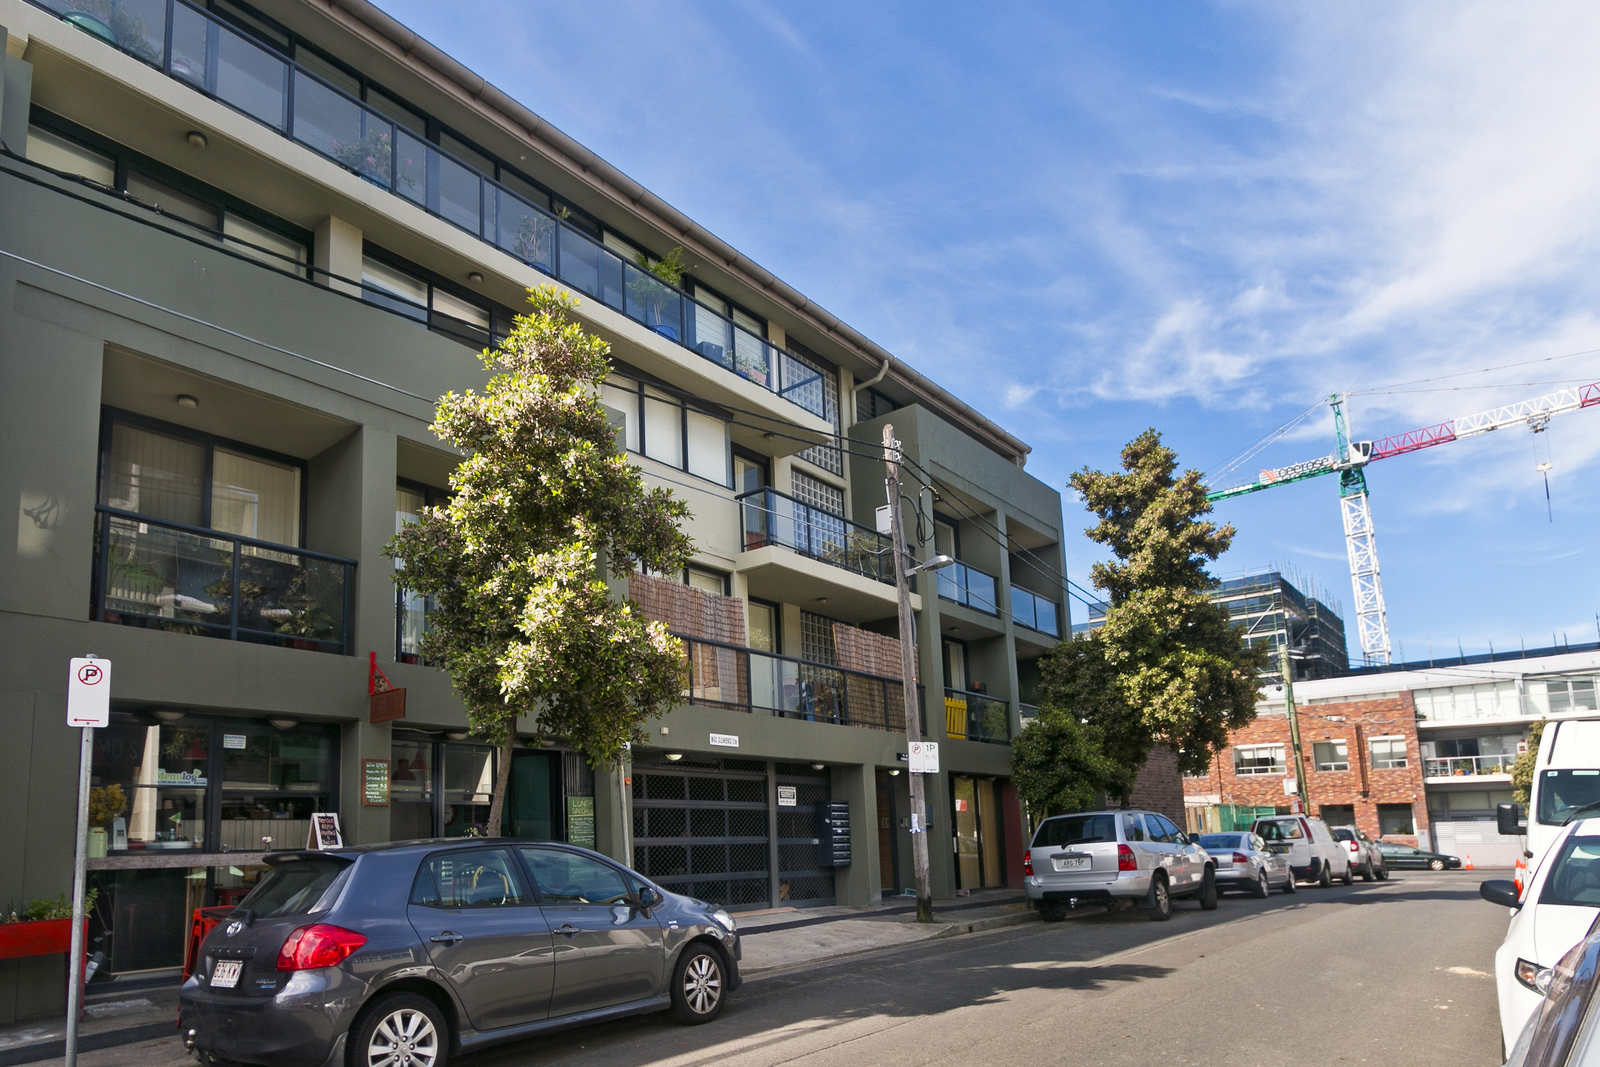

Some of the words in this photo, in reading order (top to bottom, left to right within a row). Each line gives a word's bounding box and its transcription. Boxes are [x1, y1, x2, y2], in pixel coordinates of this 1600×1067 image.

[1278, 457, 1329, 478] ceerose
[85, 669, 98, 681] P
[926, 744, 936, 752] 1P
[155, 771, 198, 782] Menulog
